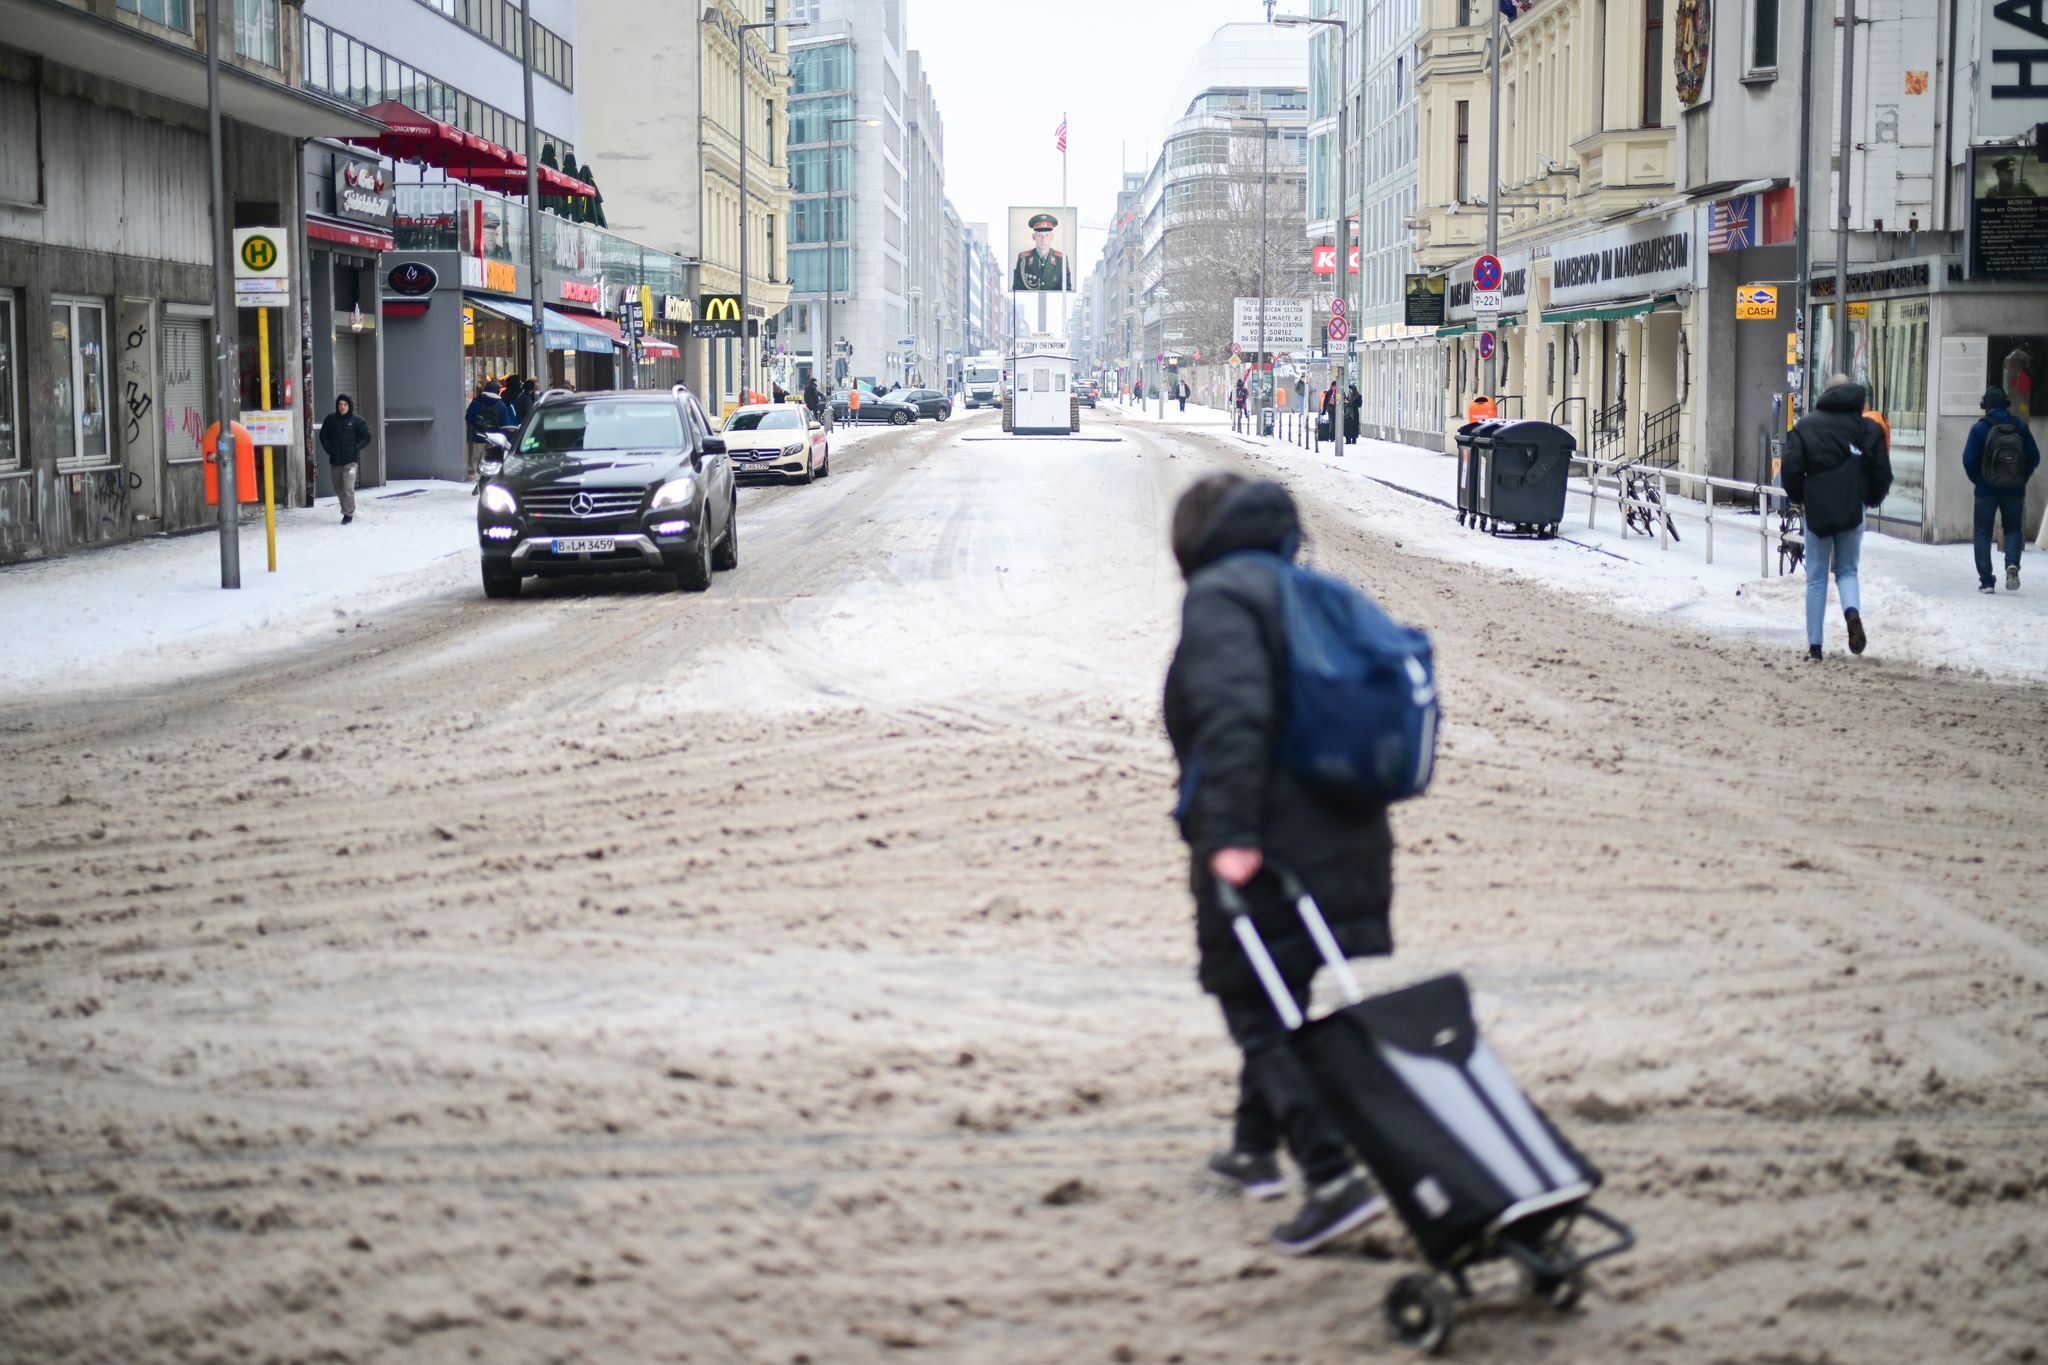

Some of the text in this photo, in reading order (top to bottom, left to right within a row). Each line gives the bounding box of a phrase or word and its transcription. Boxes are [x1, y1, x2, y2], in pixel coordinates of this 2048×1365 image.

[1554, 253, 1600, 289] MAUERSHOP
[1614, 232, 1688, 279] MAUERMUSEUM
[1747, 307, 1774, 315] CASH
[558, 540, 613, 551] B LM 3459
